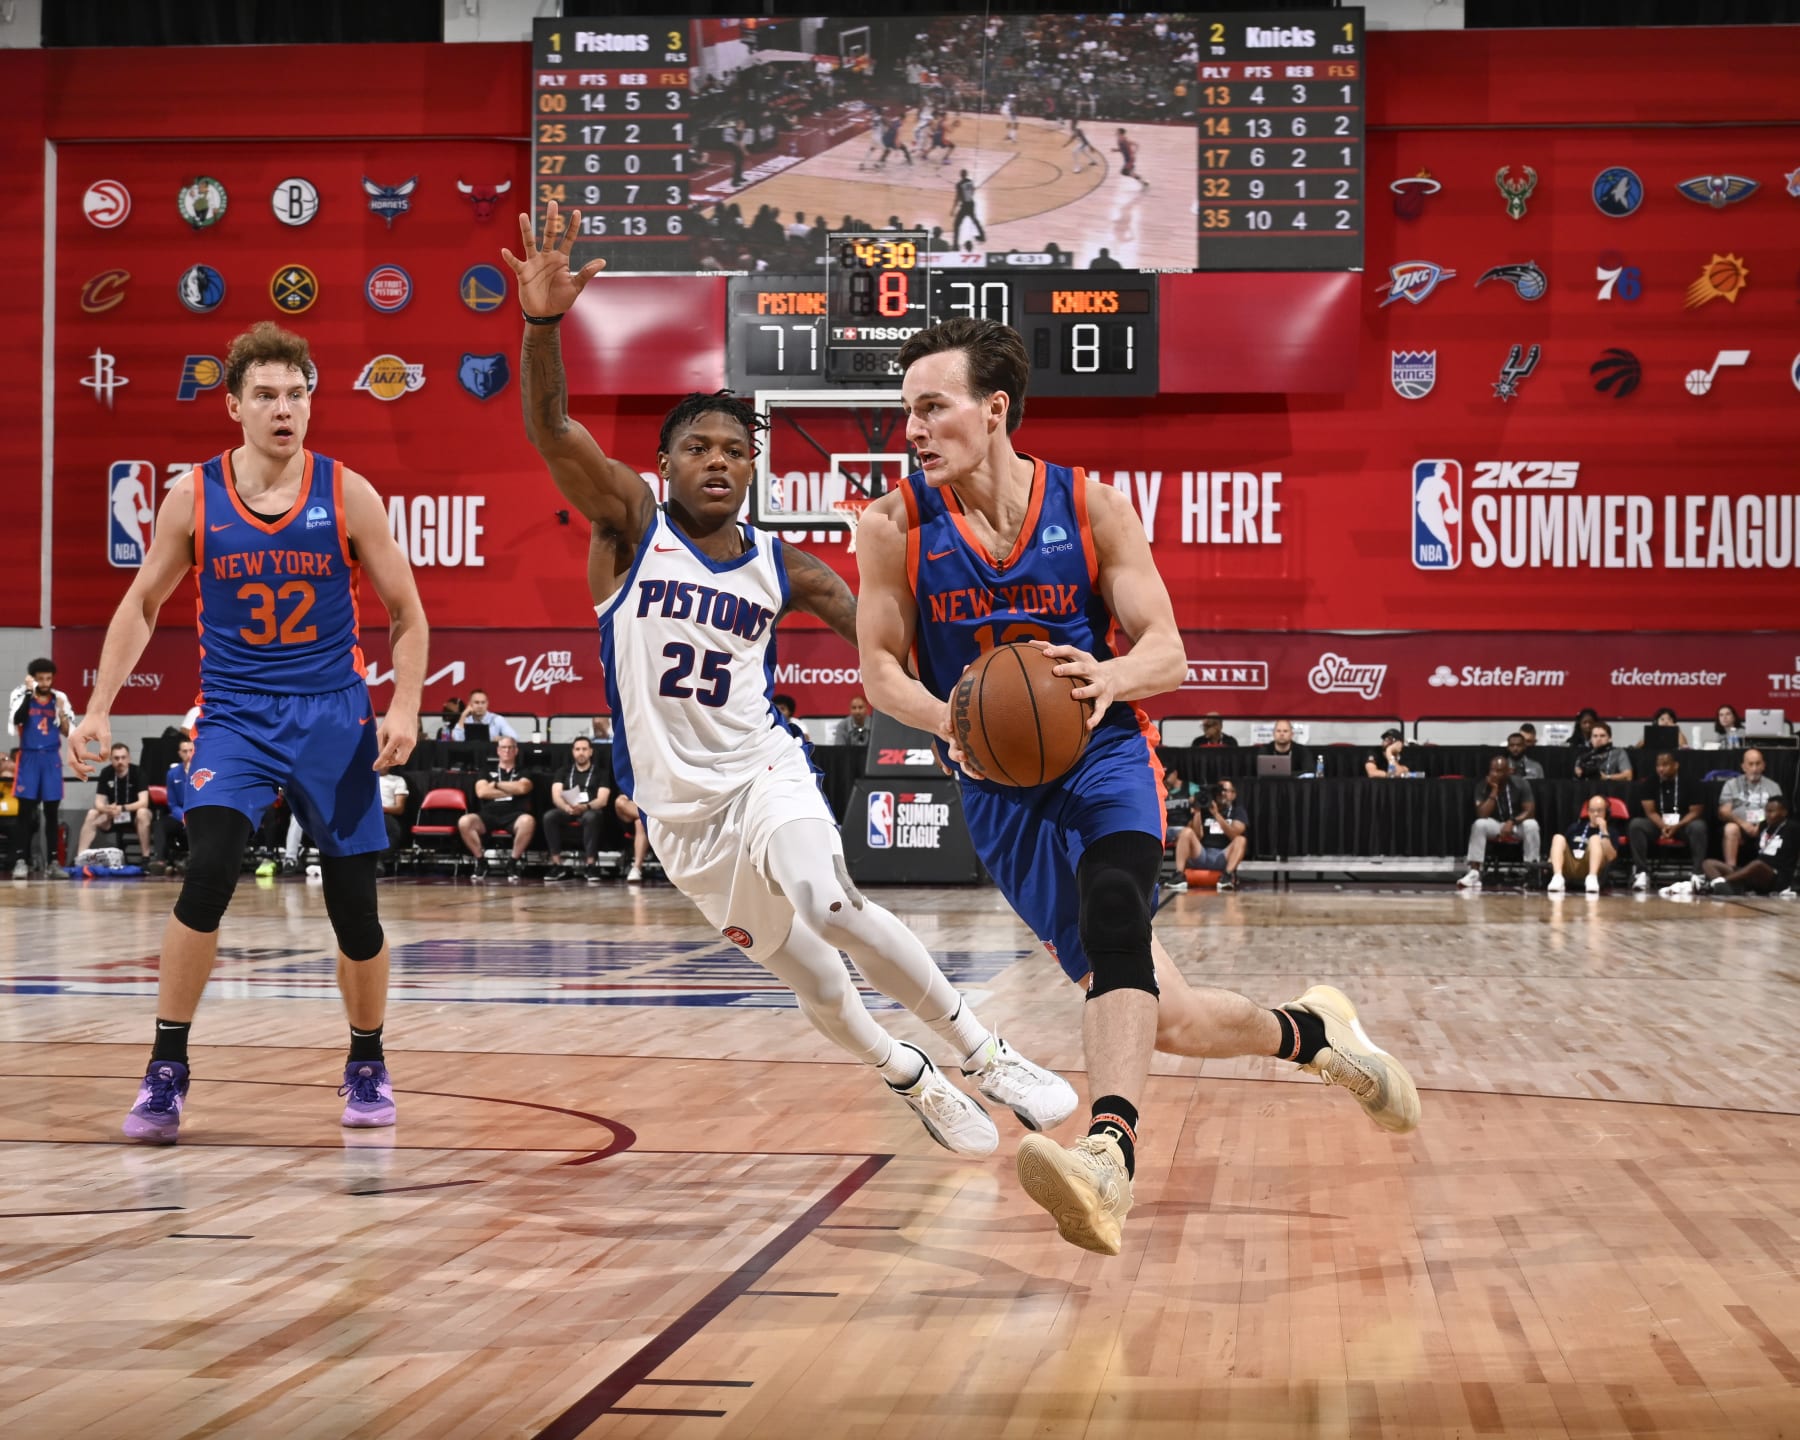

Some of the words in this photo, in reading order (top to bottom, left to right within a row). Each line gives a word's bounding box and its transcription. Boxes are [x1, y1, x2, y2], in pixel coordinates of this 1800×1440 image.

[549, 33, 561, 51] 1
[575, 32, 649, 52] Pistons
[667, 31, 682, 50] 3
[1209, 23, 1225, 43] 2
[1245, 26, 1316, 48] Knicks
[1342, 23, 1353, 42] 1
[665, 53, 687, 62] FLS
[1332, 44, 1355, 54] FLS
[539, 74, 567, 86] PLY
[579, 74, 607, 86] PTS
[619, 73, 648, 85] REB
[660, 73, 688, 85] FLS
[1202, 67, 1231, 79] PLY
[1244, 66, 1272, 78] PTS
[1285, 65, 1314, 78] REB
[1328, 65, 1356, 77] FLS
[539, 94, 567, 112] 00
[580, 94, 607, 112] 14
[625, 92, 640, 111] 5
[666, 91, 681, 110] 3
[1203, 86, 1231, 105] 13
[1250, 86, 1265, 104] 4
[1291, 84, 1307, 104] 3
[1340, 85, 1351, 104] 1
[539, 124, 567, 143] 25
[580, 125, 607, 145] 17
[625, 124, 640, 143] 2
[672, 123, 683, 142] 1
[1203, 117, 1231, 136] 14
[1245, 119, 1272, 138] 13
[1291, 117, 1307, 136] 6
[1334, 116, 1350, 135] 2
[539, 155, 567, 174] 27
[584, 154, 600, 173] 6
[624, 154, 640, 174] 0
[672, 154, 683, 172] 1
[1204, 149, 1231, 168] 17
[1250, 148, 1265, 167] 6
[1291, 148, 1307, 168] 2
[1340, 147, 1351, 166] 1
[539, 184, 566, 203] 34
[584, 185, 600, 205] 9
[624, 185, 640, 204] 7
[666, 186, 681, 205] 3
[1203, 178, 1231, 198] 32
[1249, 179, 1265, 199] 9
[1295, 179, 1306, 198] 1
[1334, 179, 1350, 199] 2
[289, 186, 303, 219] B
[581, 216, 607, 235] 15
[620, 217, 647, 235] 13
[666, 215, 682, 234] 6
[1203, 209, 1231, 228] 35
[1245, 210, 1272, 230] 10
[1291, 211, 1307, 230] 4
[1335, 210, 1350, 229] 2
[855, 241, 916, 269] 4:30
[961, 254, 981, 263] 77
[1597, 266, 1641, 300] 76
[879, 272, 908, 317] 8
[1052, 291, 1119, 313] KNICKS
[760, 325, 817, 371] 77
[1072, 323, 1134, 373] 81
[1394, 370, 1434, 379] KINGS
[1471, 461, 1580, 489] 2K25
[1181, 471, 1282, 544] HERE
[386, 495, 485, 567] AGUE
[1470, 494, 1654, 569] SUMMER
[115, 543, 137, 560] NBA
[1041, 542, 1073, 556] sphere
[1420, 544, 1443, 562] NBA
[212, 551, 264, 580] NEW
[268, 550, 332, 577] YORK
[237, 580, 318, 645] 32
[636, 580, 775, 642] PISTONS
[929, 587, 995, 623] NEW
[1000, 584, 1078, 616] YORK
[83, 669, 163, 691] Hessy
[505, 653, 583, 694] Vegas
[659, 642, 733, 708] 25
[774, 663, 864, 684] Microso
[1185, 668, 1259, 682] ANINI
[1310, 655, 1385, 697] Starry
[1610, 667, 1726, 686] ticketmaster
[1768, 674, 1800, 690] TIS
[37, 717, 48, 736] 4
[897, 804, 949, 827] SUMMER
[897, 826, 940, 848] LEAGUE
